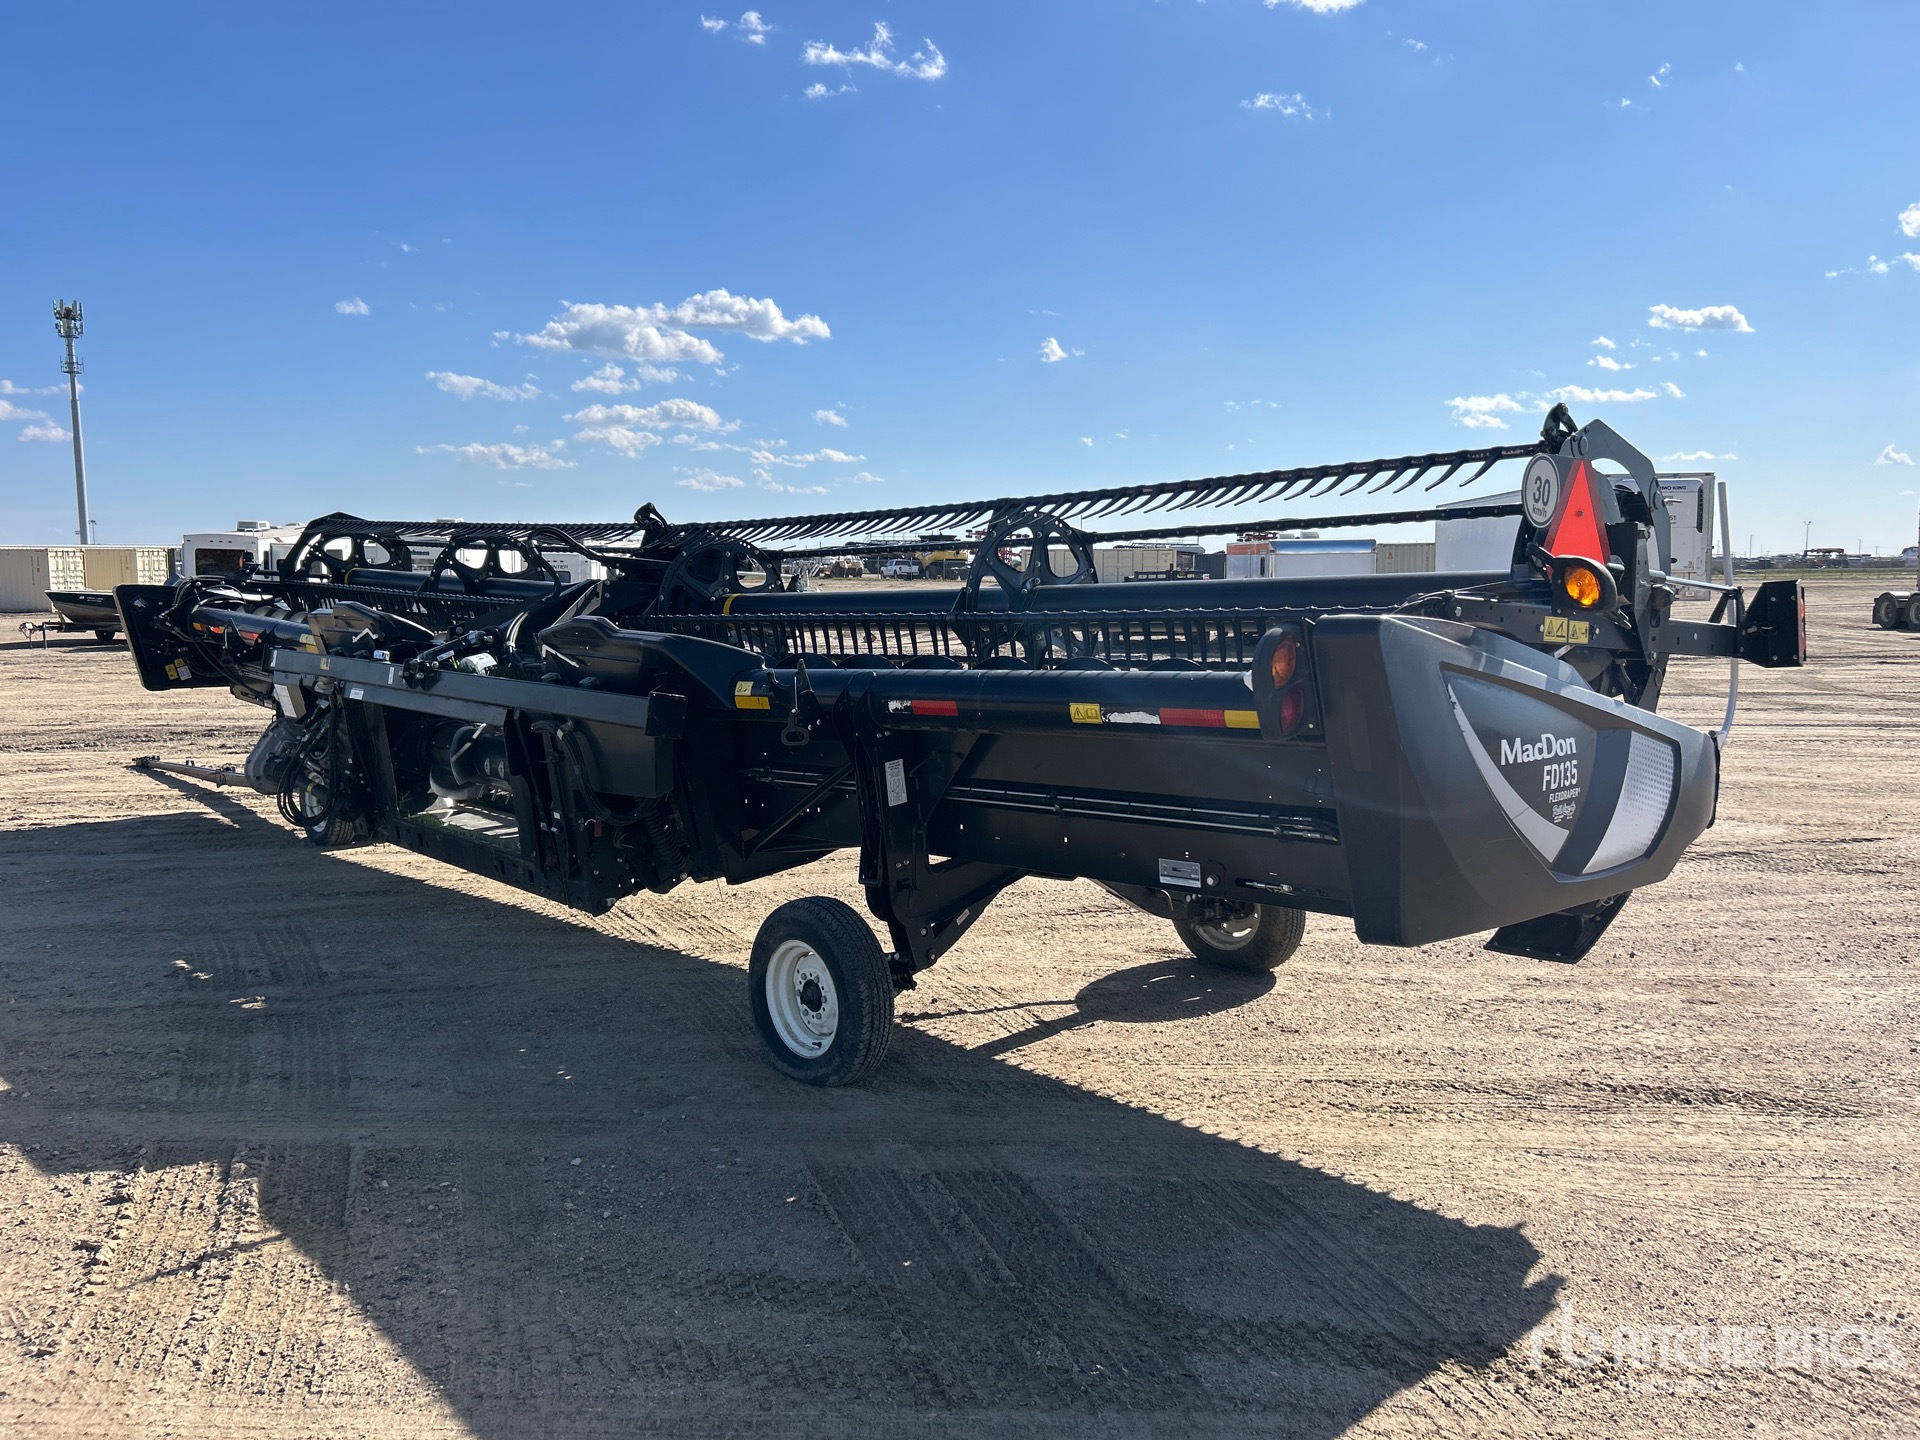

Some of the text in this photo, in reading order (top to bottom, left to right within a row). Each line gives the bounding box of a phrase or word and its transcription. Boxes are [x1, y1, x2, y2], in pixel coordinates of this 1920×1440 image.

[1532, 475, 1551, 507] 30
[1531, 504, 1548, 518] km/h
[1500, 733, 1577, 766] MacDon
[1542, 759, 1578, 792] FD135
